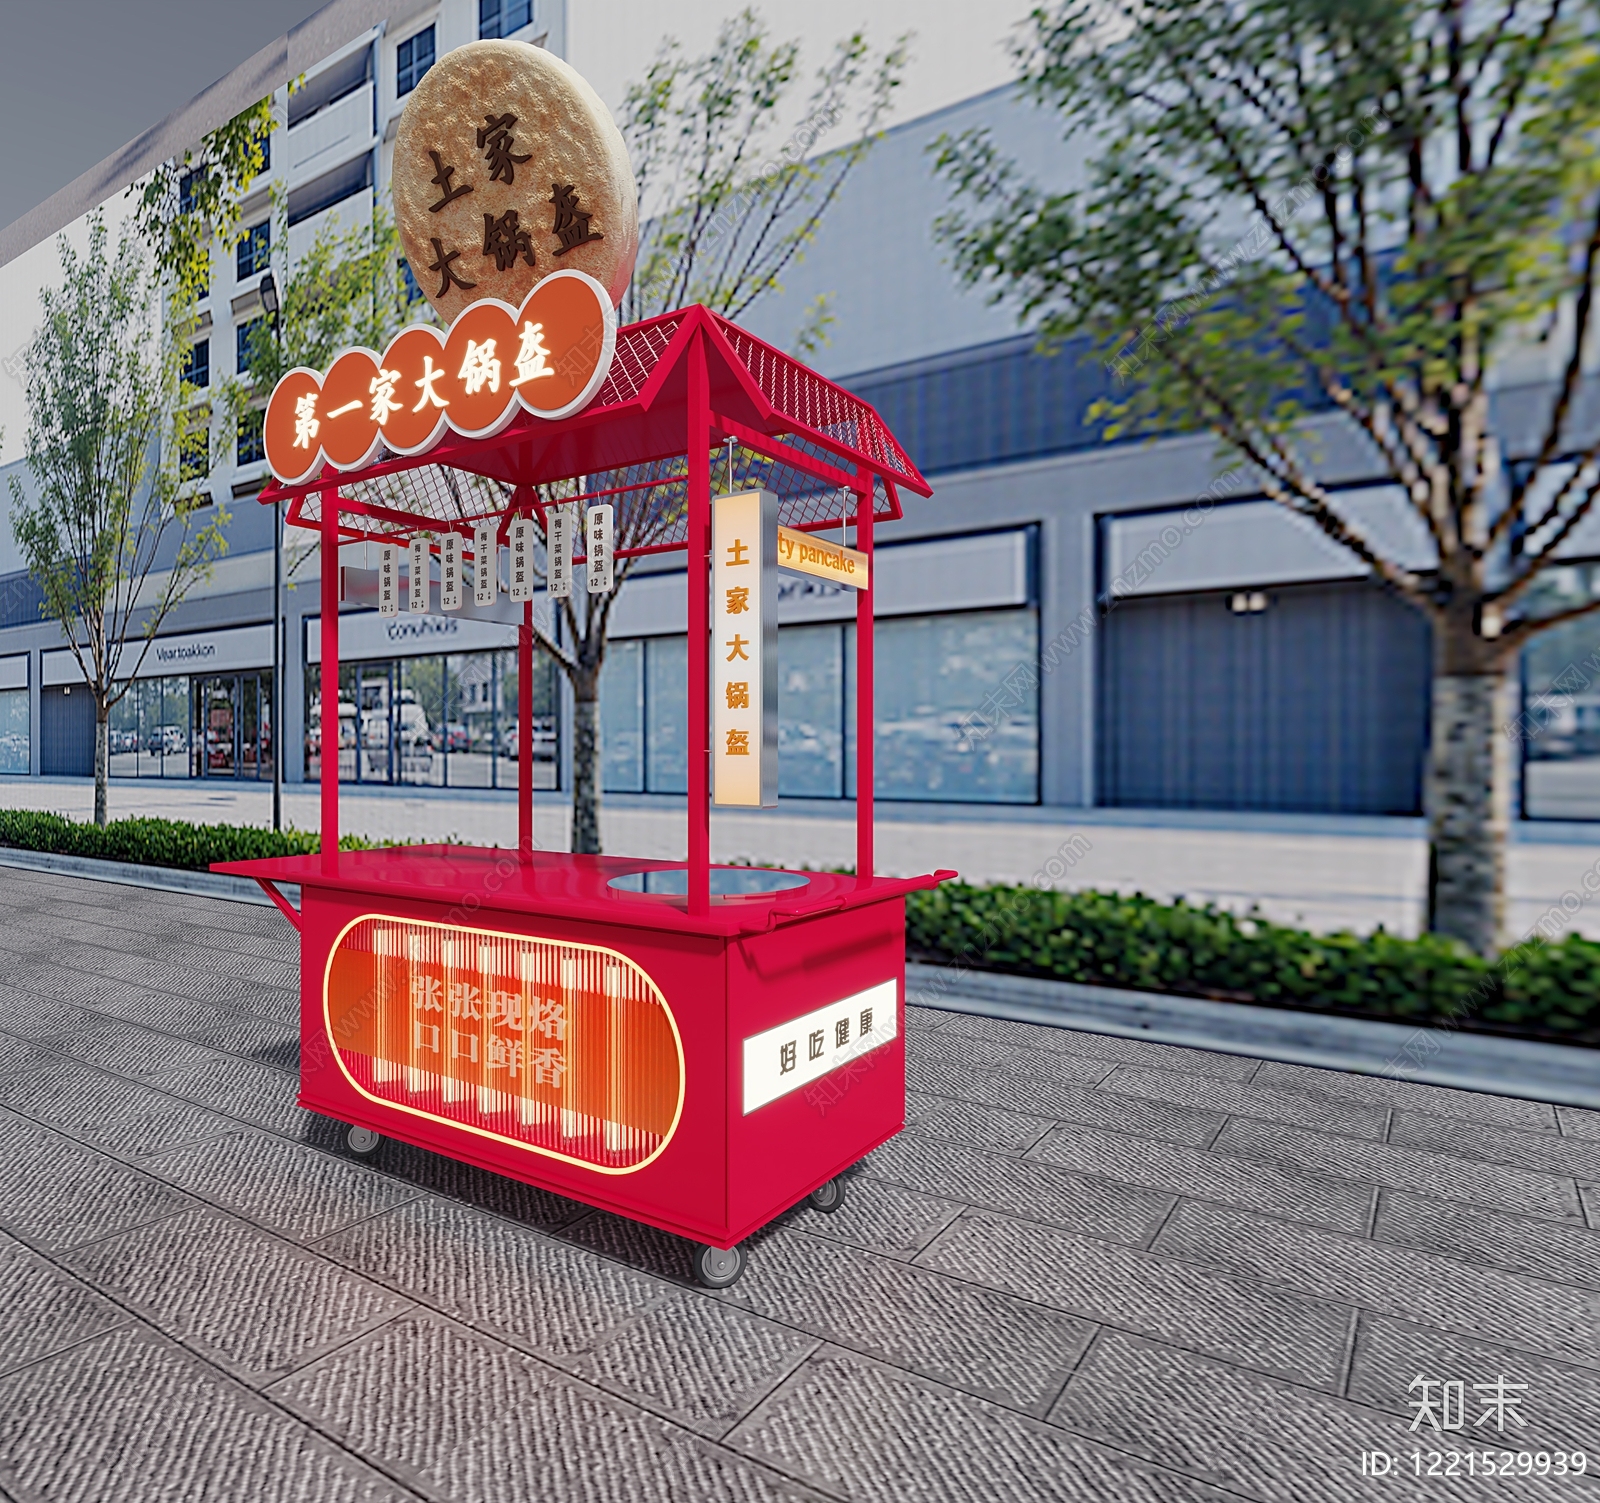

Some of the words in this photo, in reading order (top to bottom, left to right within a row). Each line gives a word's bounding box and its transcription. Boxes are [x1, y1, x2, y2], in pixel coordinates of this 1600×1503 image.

[429, 113, 533, 213] 土家
[429, 184, 604, 299] 大锅盔
[293, 321, 555, 449] 第一家大锅盔
[445, 538, 454, 593] 原味锅盔
[515, 526, 525, 583] 原味锅盔
[593, 512, 604, 573] 原味锅盔
[800, 543, 855, 574] pancake
[380, 605, 388, 613] 12
[411, 601, 418, 609] 12
[442, 597, 450, 605] 12
[476, 593, 484, 601] 12
[512, 588, 520, 596] 12
[550, 583, 558, 592] 12
[590, 578, 599, 587] 12
[725, 538, 750, 756] 土家大锅盔
[411, 975, 568, 1041] 张张现烙
[413, 1019, 568, 1089] 口口鲜香
[779, 1006, 873, 1076] 好吃健康
